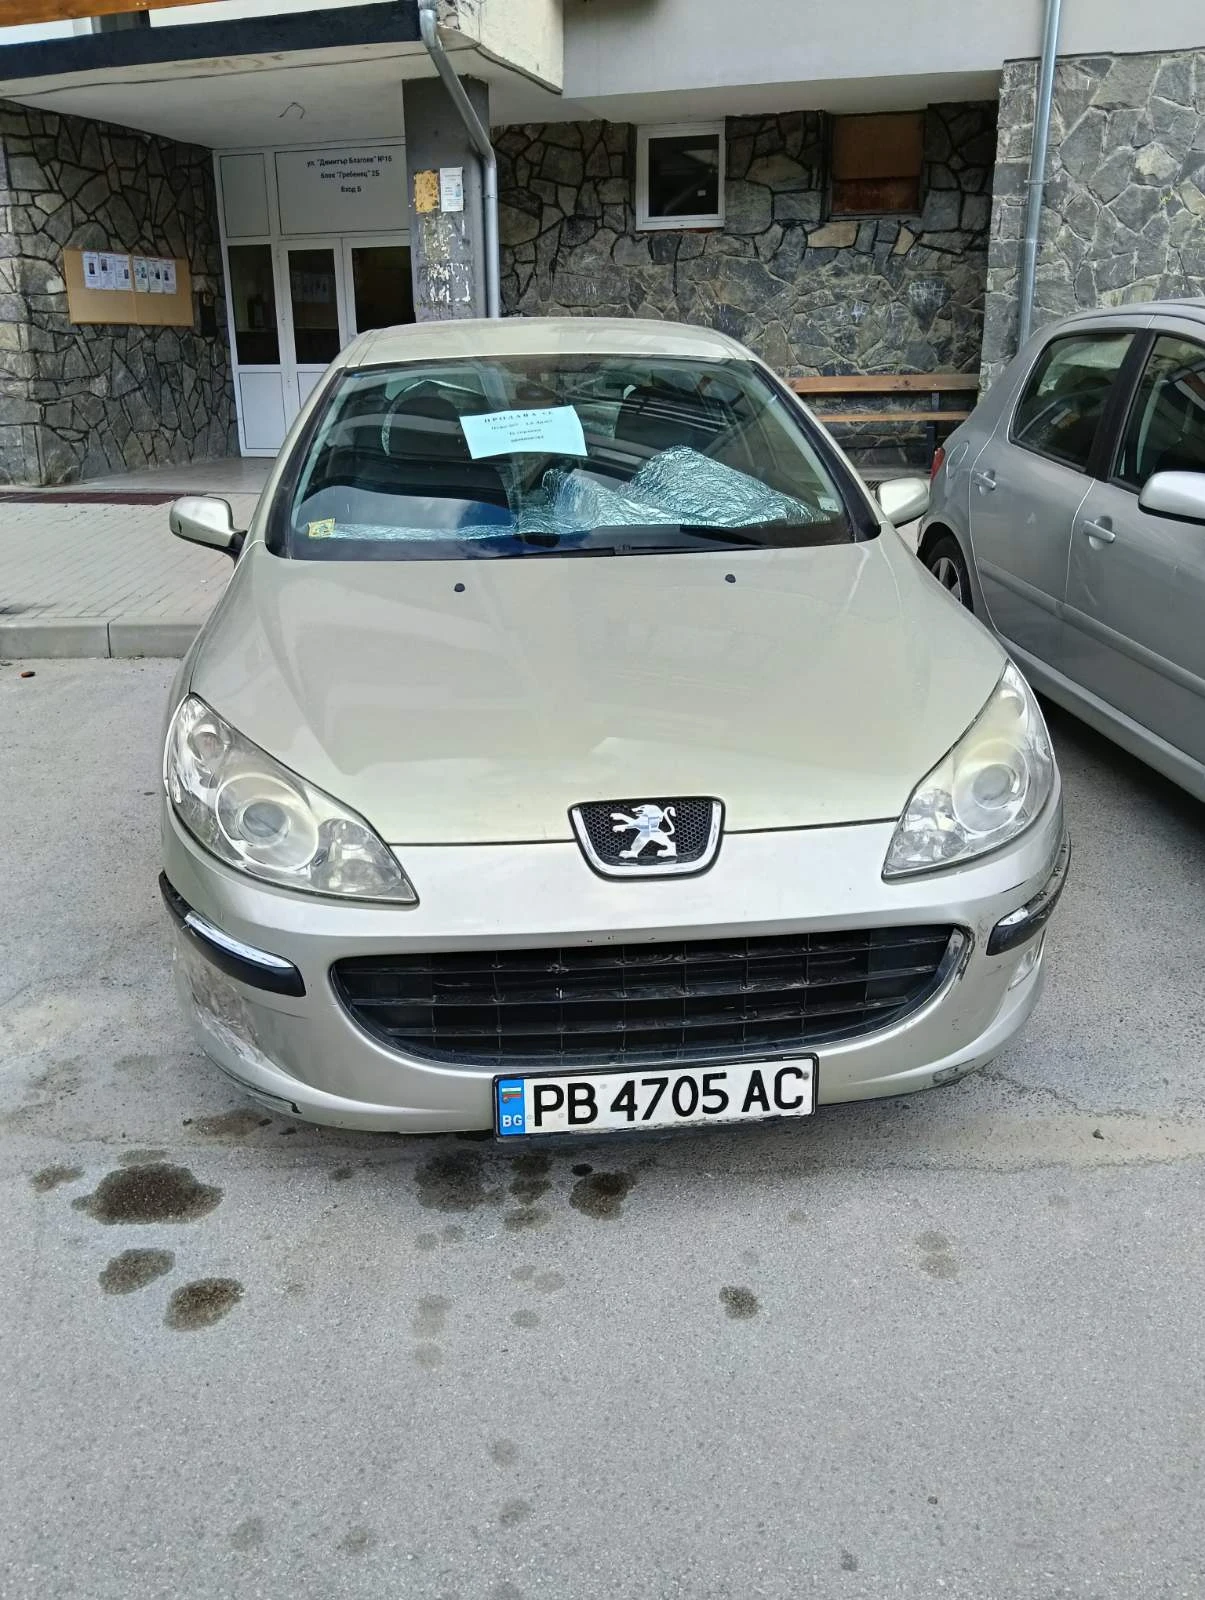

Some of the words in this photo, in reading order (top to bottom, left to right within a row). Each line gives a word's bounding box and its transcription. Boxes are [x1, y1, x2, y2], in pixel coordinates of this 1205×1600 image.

[533, 1082, 599, 1127] PB
[610, 1072, 730, 1122] 4705
[741, 1066, 804, 1113] AC
[502, 1115, 523, 1128] BG
